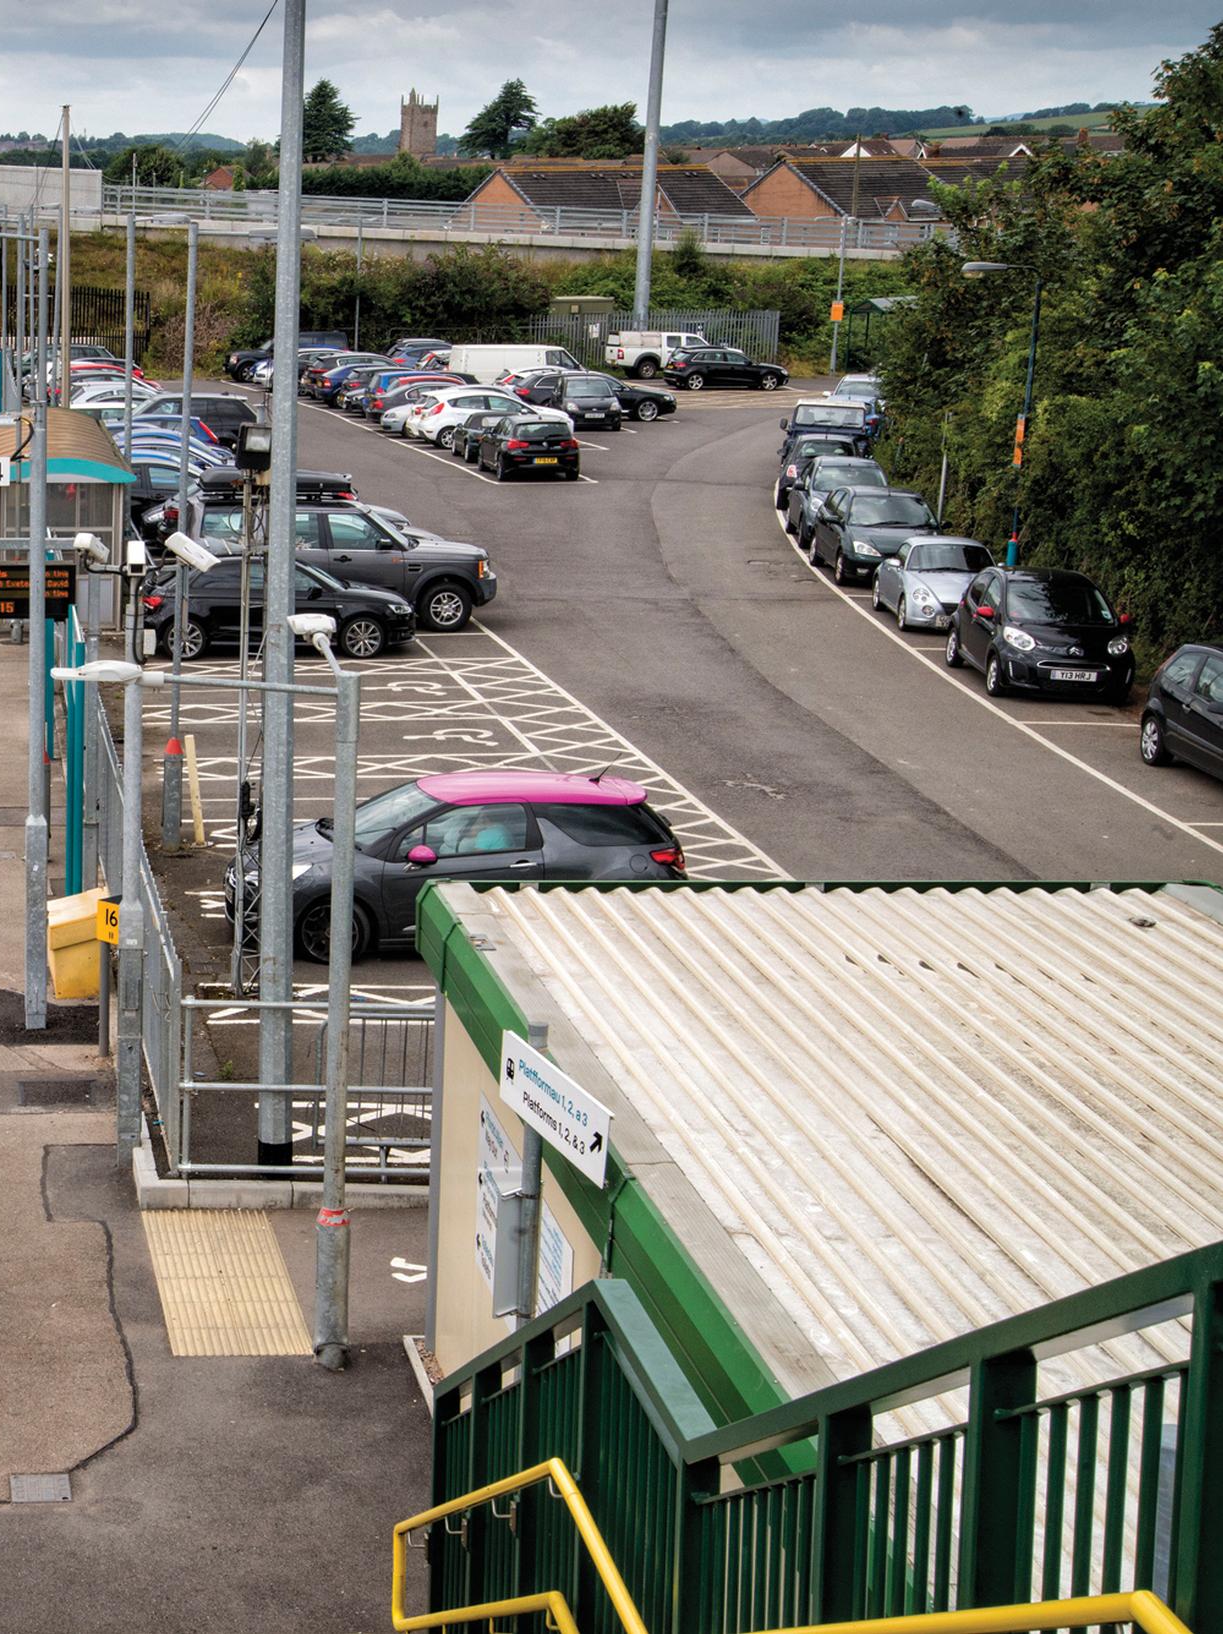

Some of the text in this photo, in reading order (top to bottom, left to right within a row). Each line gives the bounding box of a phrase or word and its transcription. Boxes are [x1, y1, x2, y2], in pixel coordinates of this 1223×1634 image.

[105, 908, 118, 927] 16
[522, 1091, 558, 1131] Platforms
[572, 1134, 579, 1150] &
[579, 1140, 585, 1155] 3
[582, 1112, 588, 1127] 3
